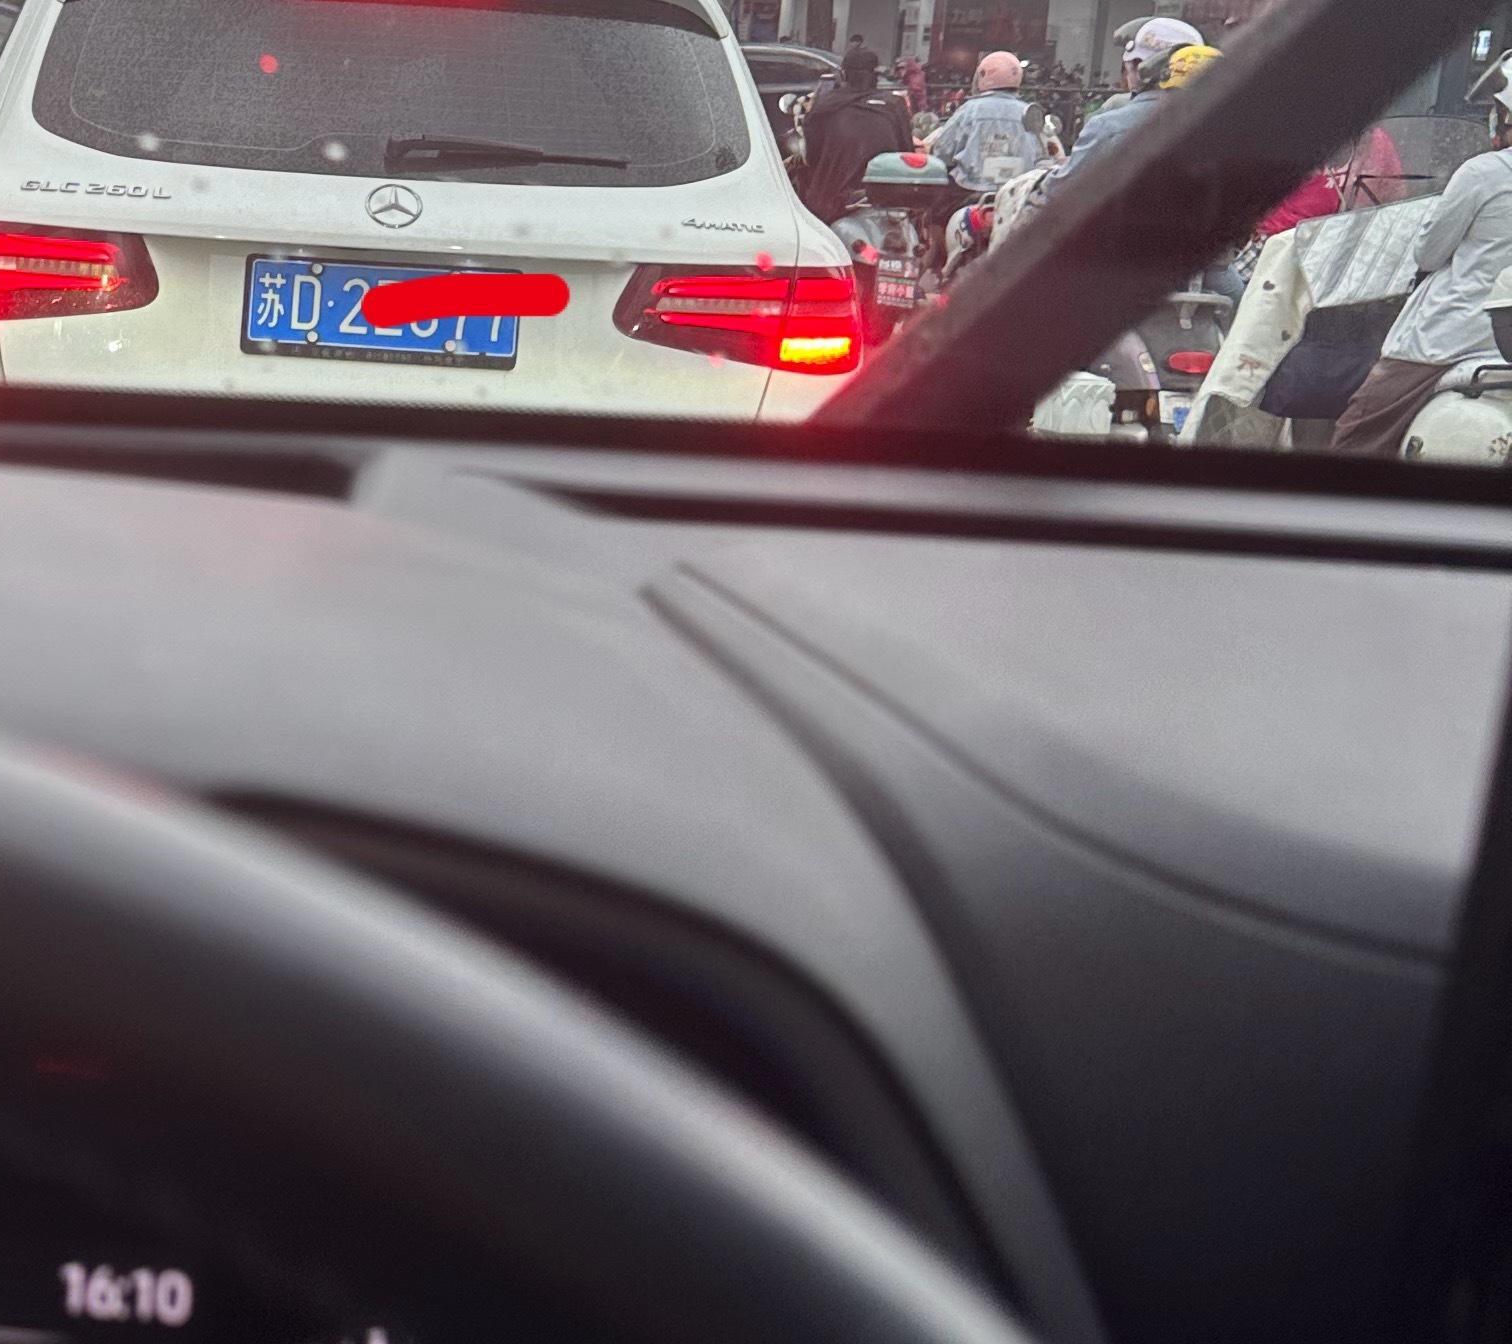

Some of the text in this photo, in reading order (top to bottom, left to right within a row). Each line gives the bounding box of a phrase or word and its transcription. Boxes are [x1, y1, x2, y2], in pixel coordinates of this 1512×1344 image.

[20, 180, 172, 199] GLC 260 L
[59, 1262, 193, 1327] 16:10
